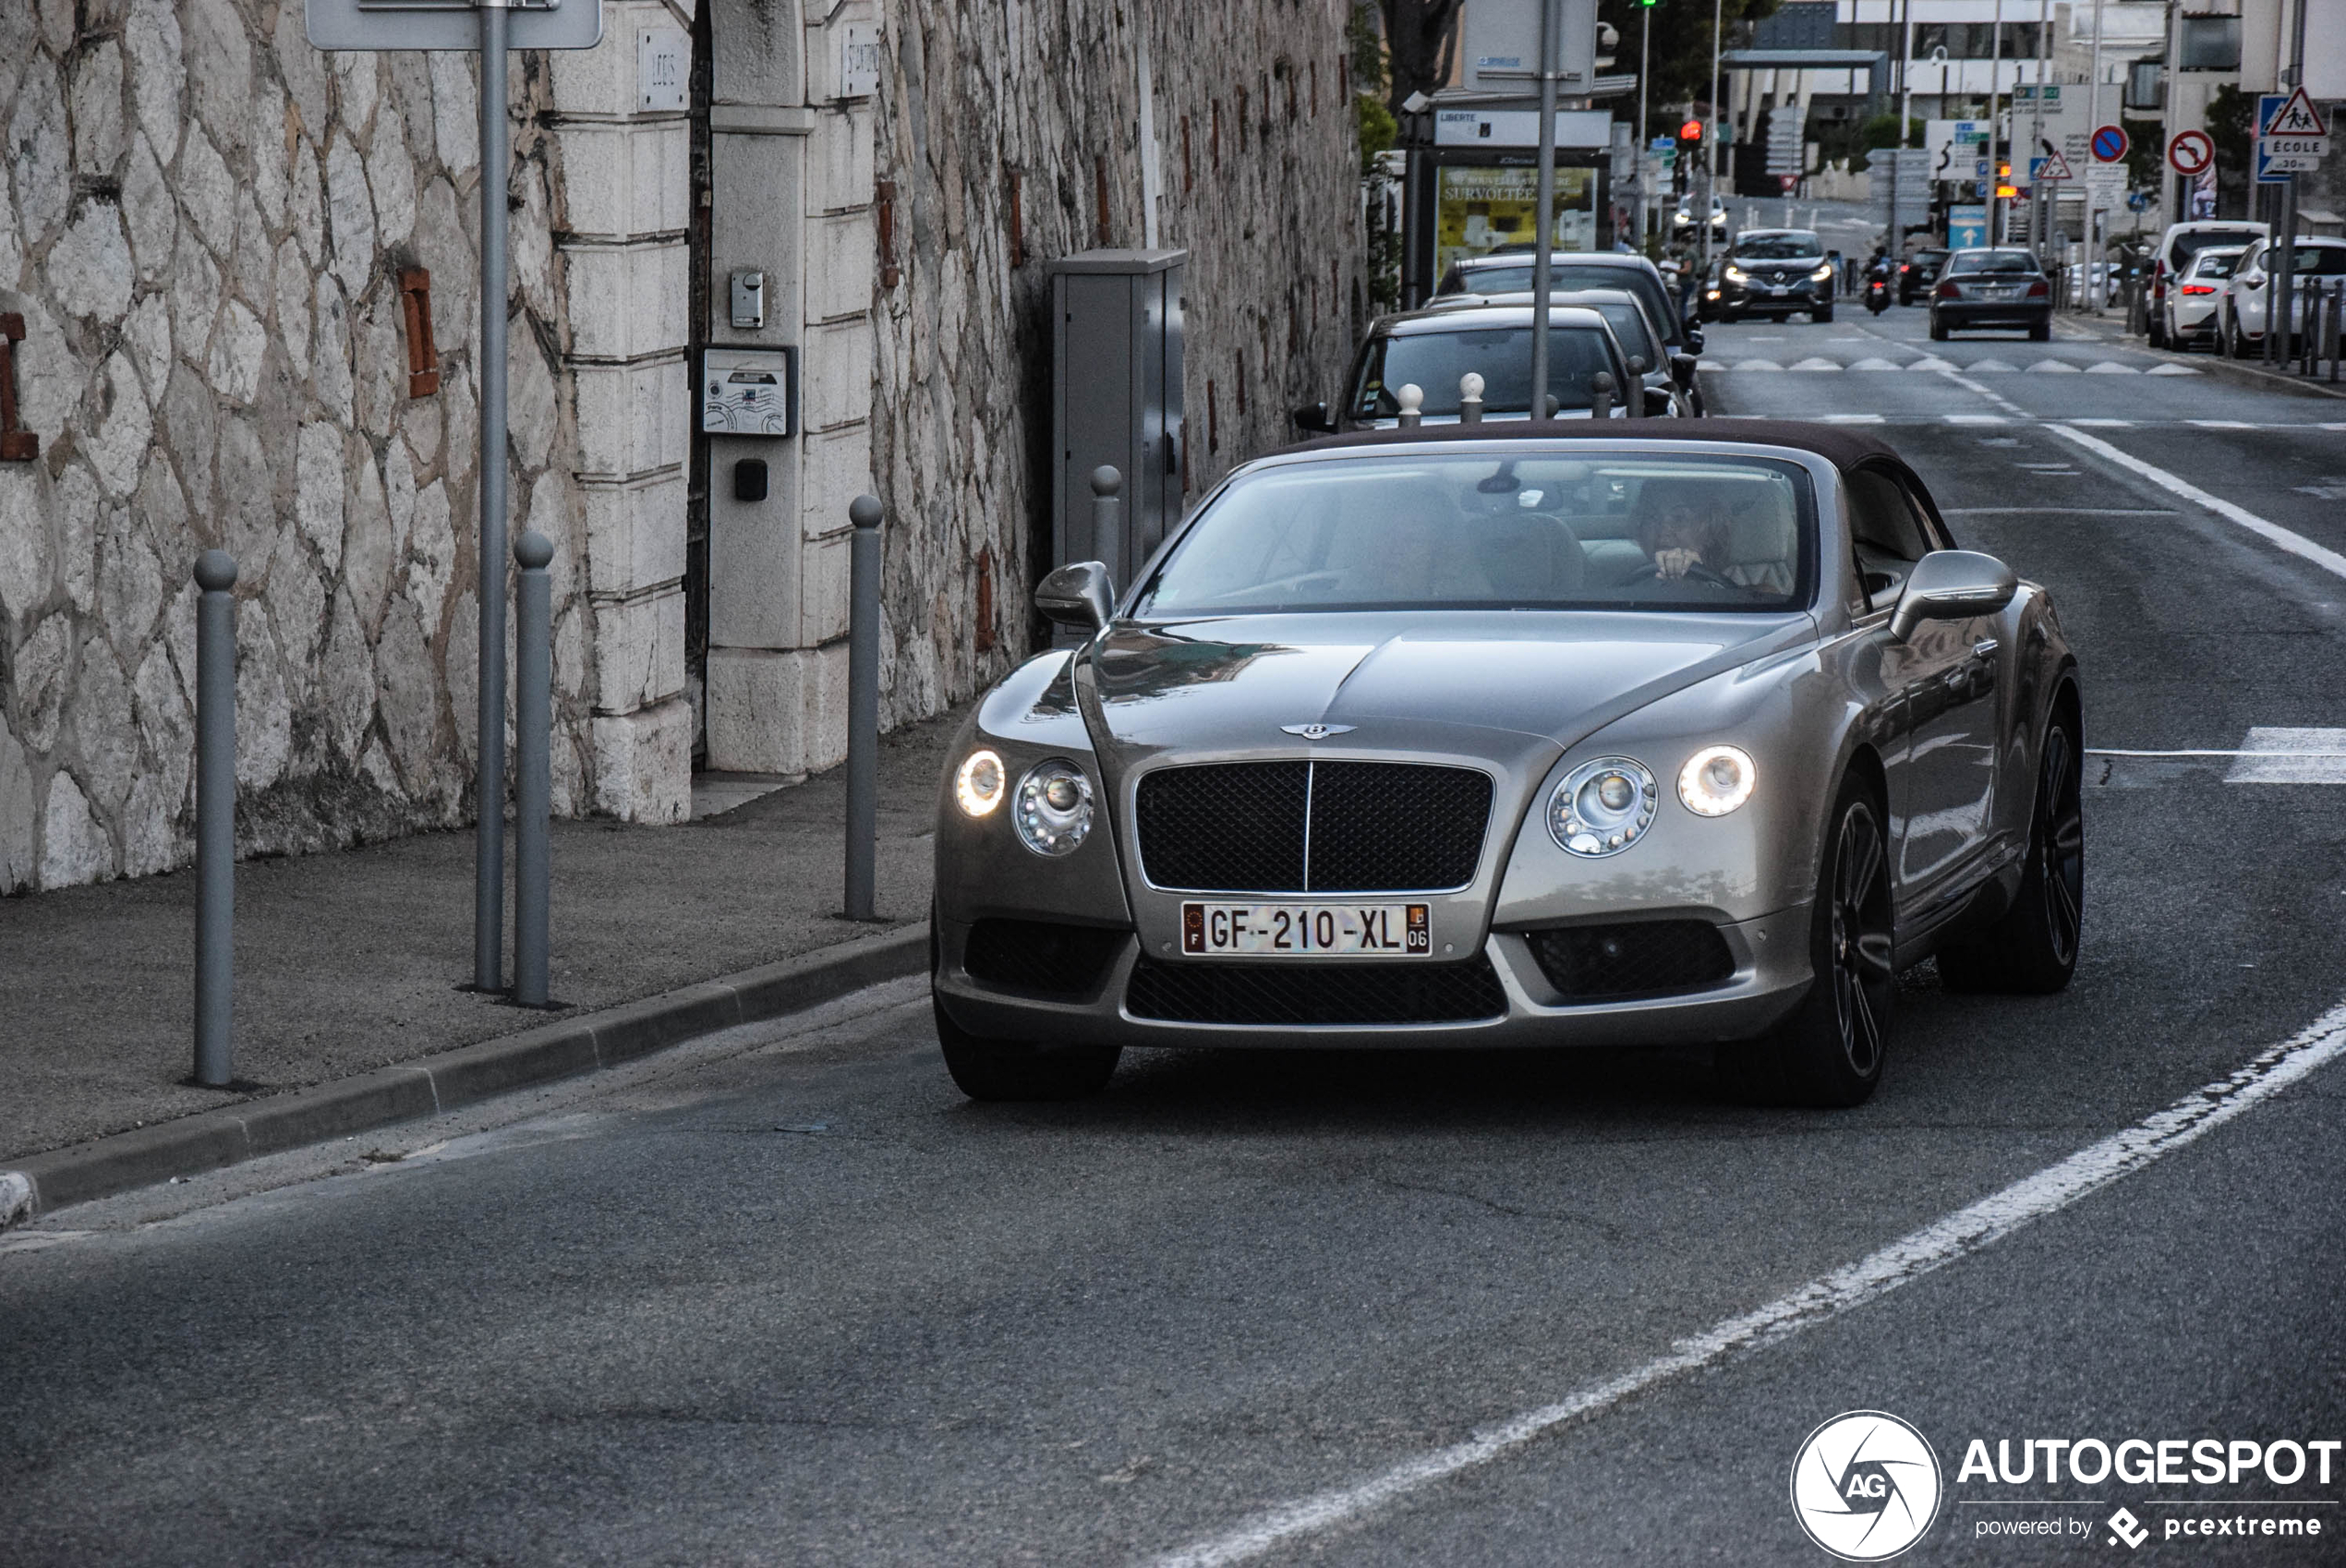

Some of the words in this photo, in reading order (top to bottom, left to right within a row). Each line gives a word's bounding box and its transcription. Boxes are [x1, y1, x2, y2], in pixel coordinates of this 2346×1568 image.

[1441, 113, 1477, 122] LIBERTE
[2273, 139, 2320, 152] ÉCOLE
[1191, 934, 1200, 946] F
[1210, 909, 1401, 949] GF-210-XL
[1408, 930, 1427, 947] 06
